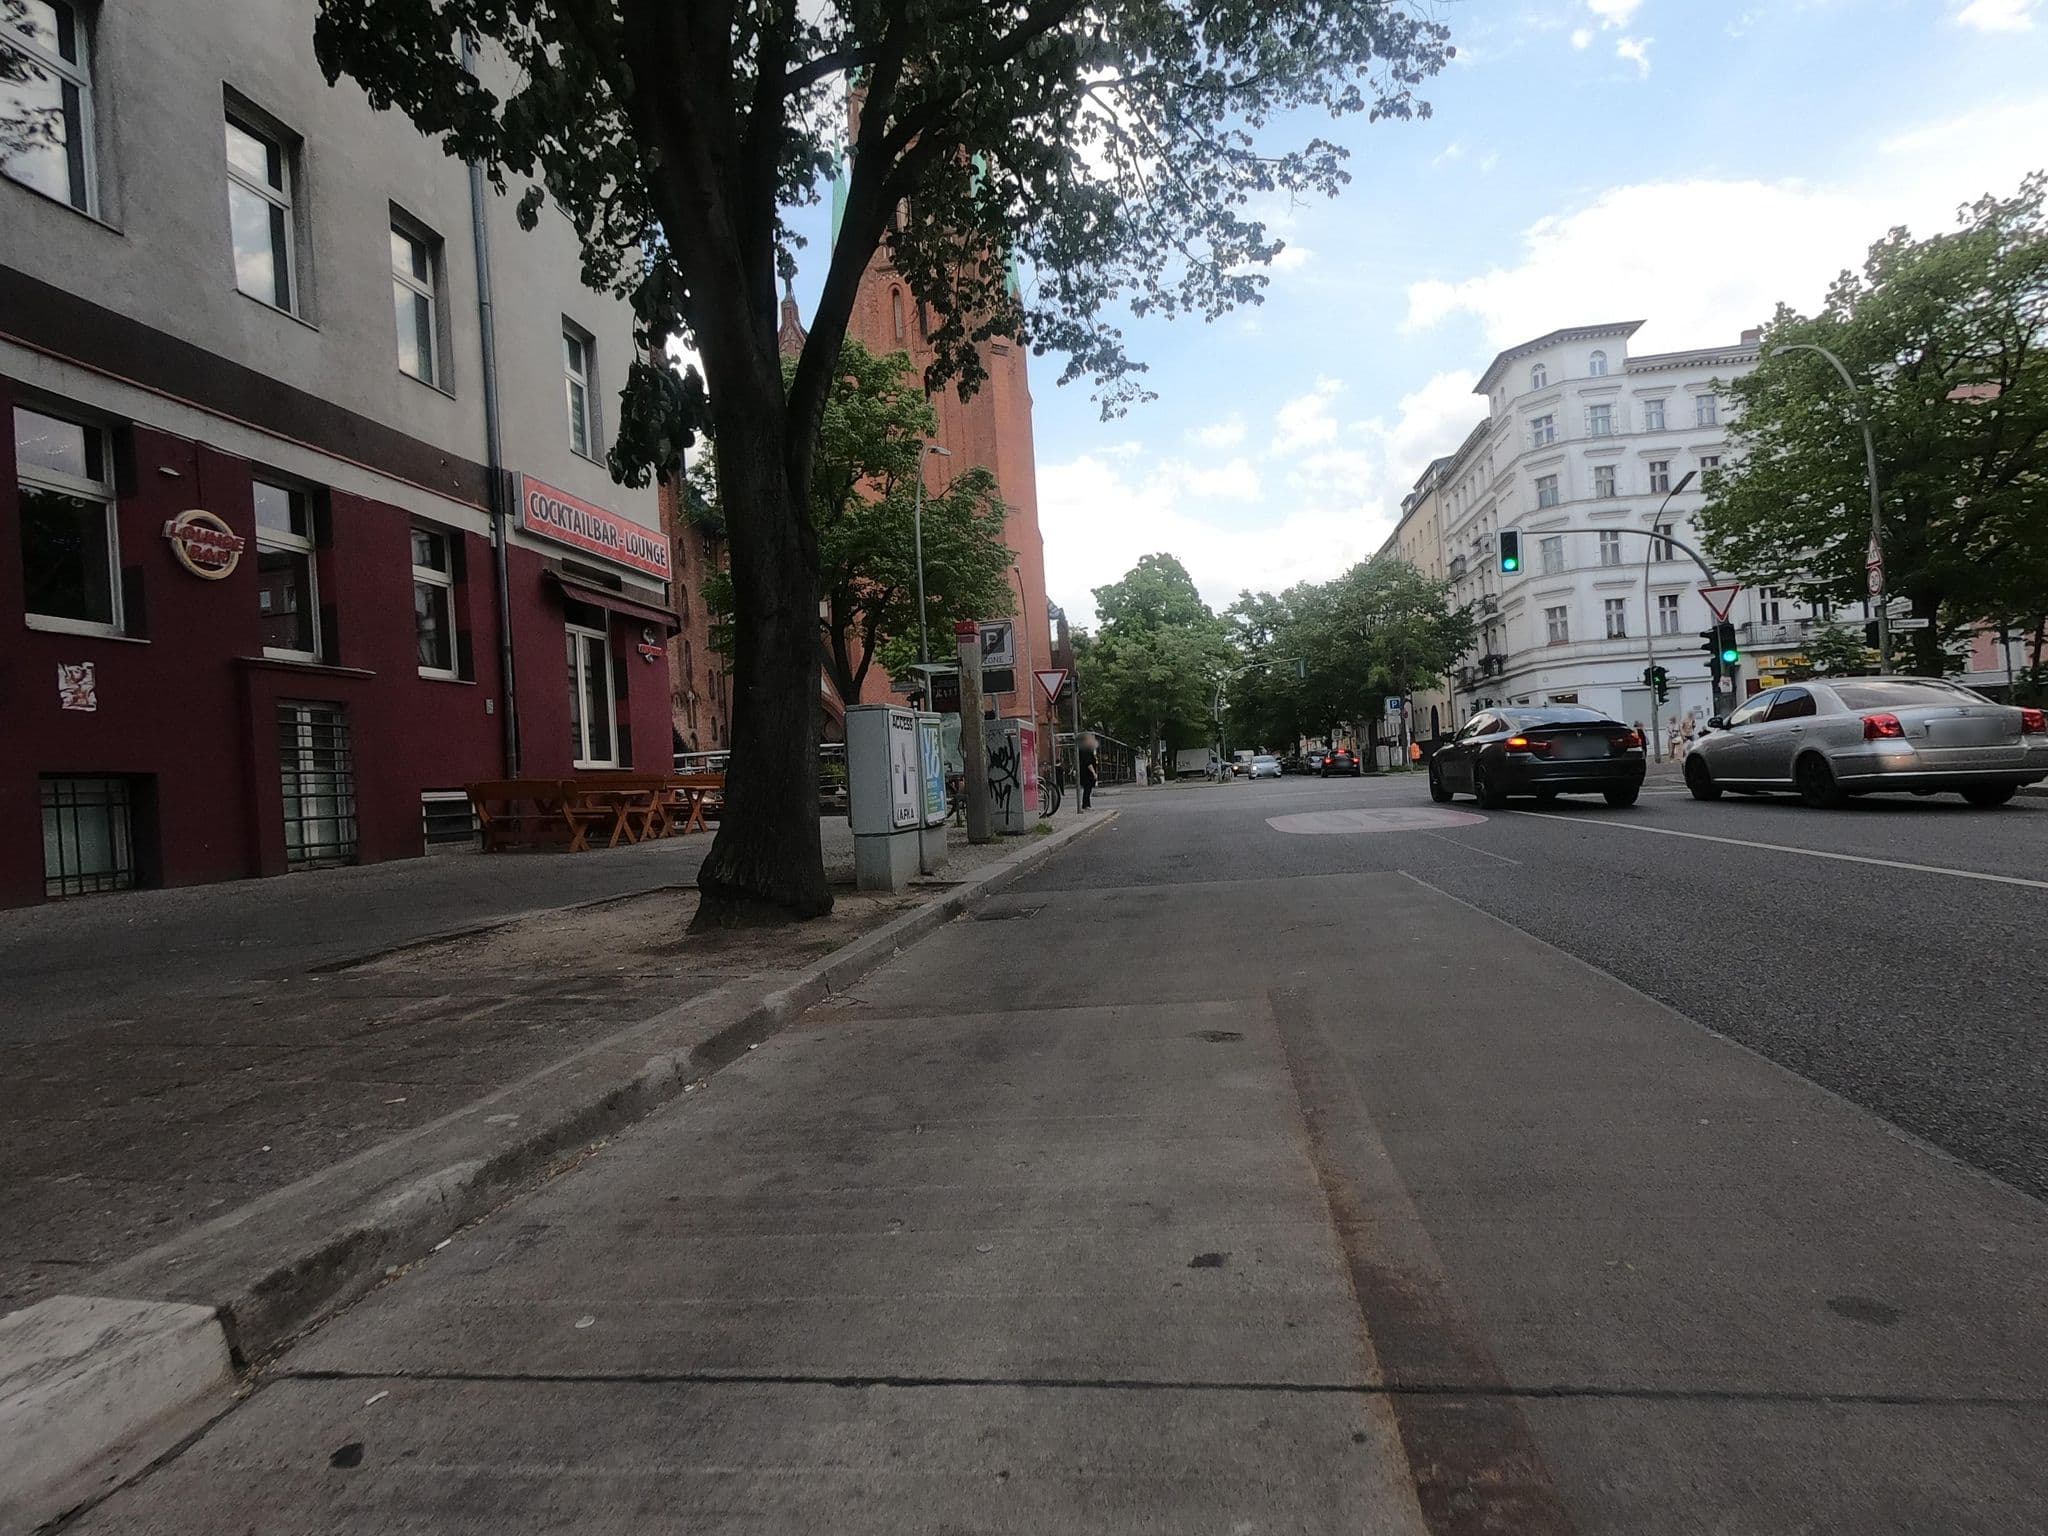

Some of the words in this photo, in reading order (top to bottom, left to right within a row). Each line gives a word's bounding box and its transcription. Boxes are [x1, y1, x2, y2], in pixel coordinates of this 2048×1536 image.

[169, 521, 246, 553] LOUNGE
[530, 492, 618, 548] COCKTAILBAR
[625, 531, 666, 566] LOUNGE
[189, 543, 230, 564] BAR
[892, 715, 913, 731] ACCESS
